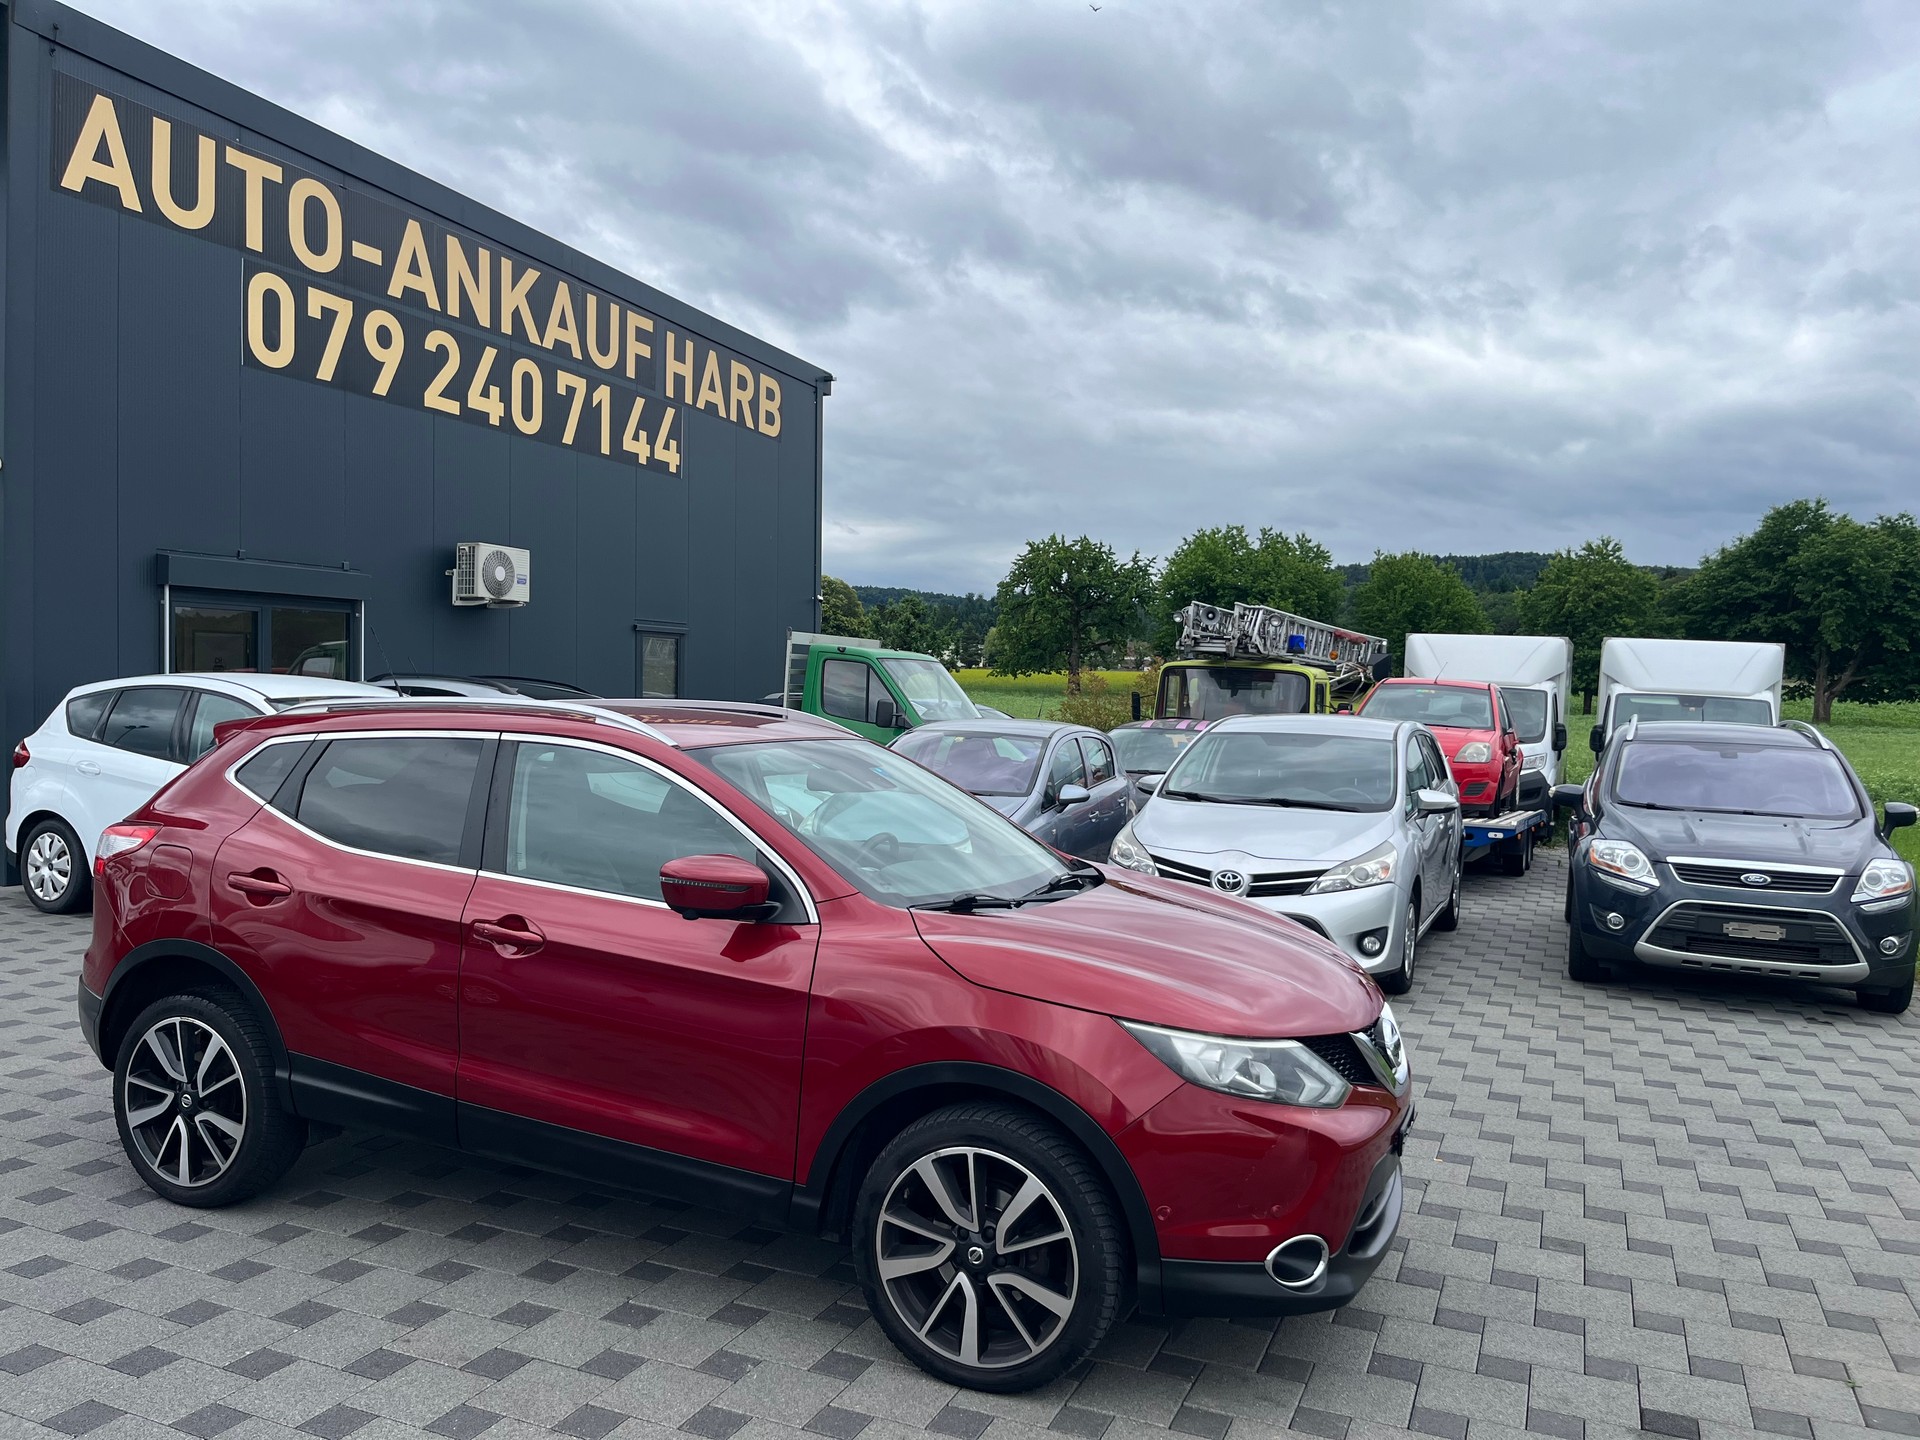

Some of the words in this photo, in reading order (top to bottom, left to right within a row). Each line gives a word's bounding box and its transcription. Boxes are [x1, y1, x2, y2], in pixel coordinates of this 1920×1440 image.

[61, 94, 654, 378] AUTO-ANKAUF
[665, 331, 782, 438] HARB
[247, 271, 405, 396] 079
[424, 330, 543, 435] 240
